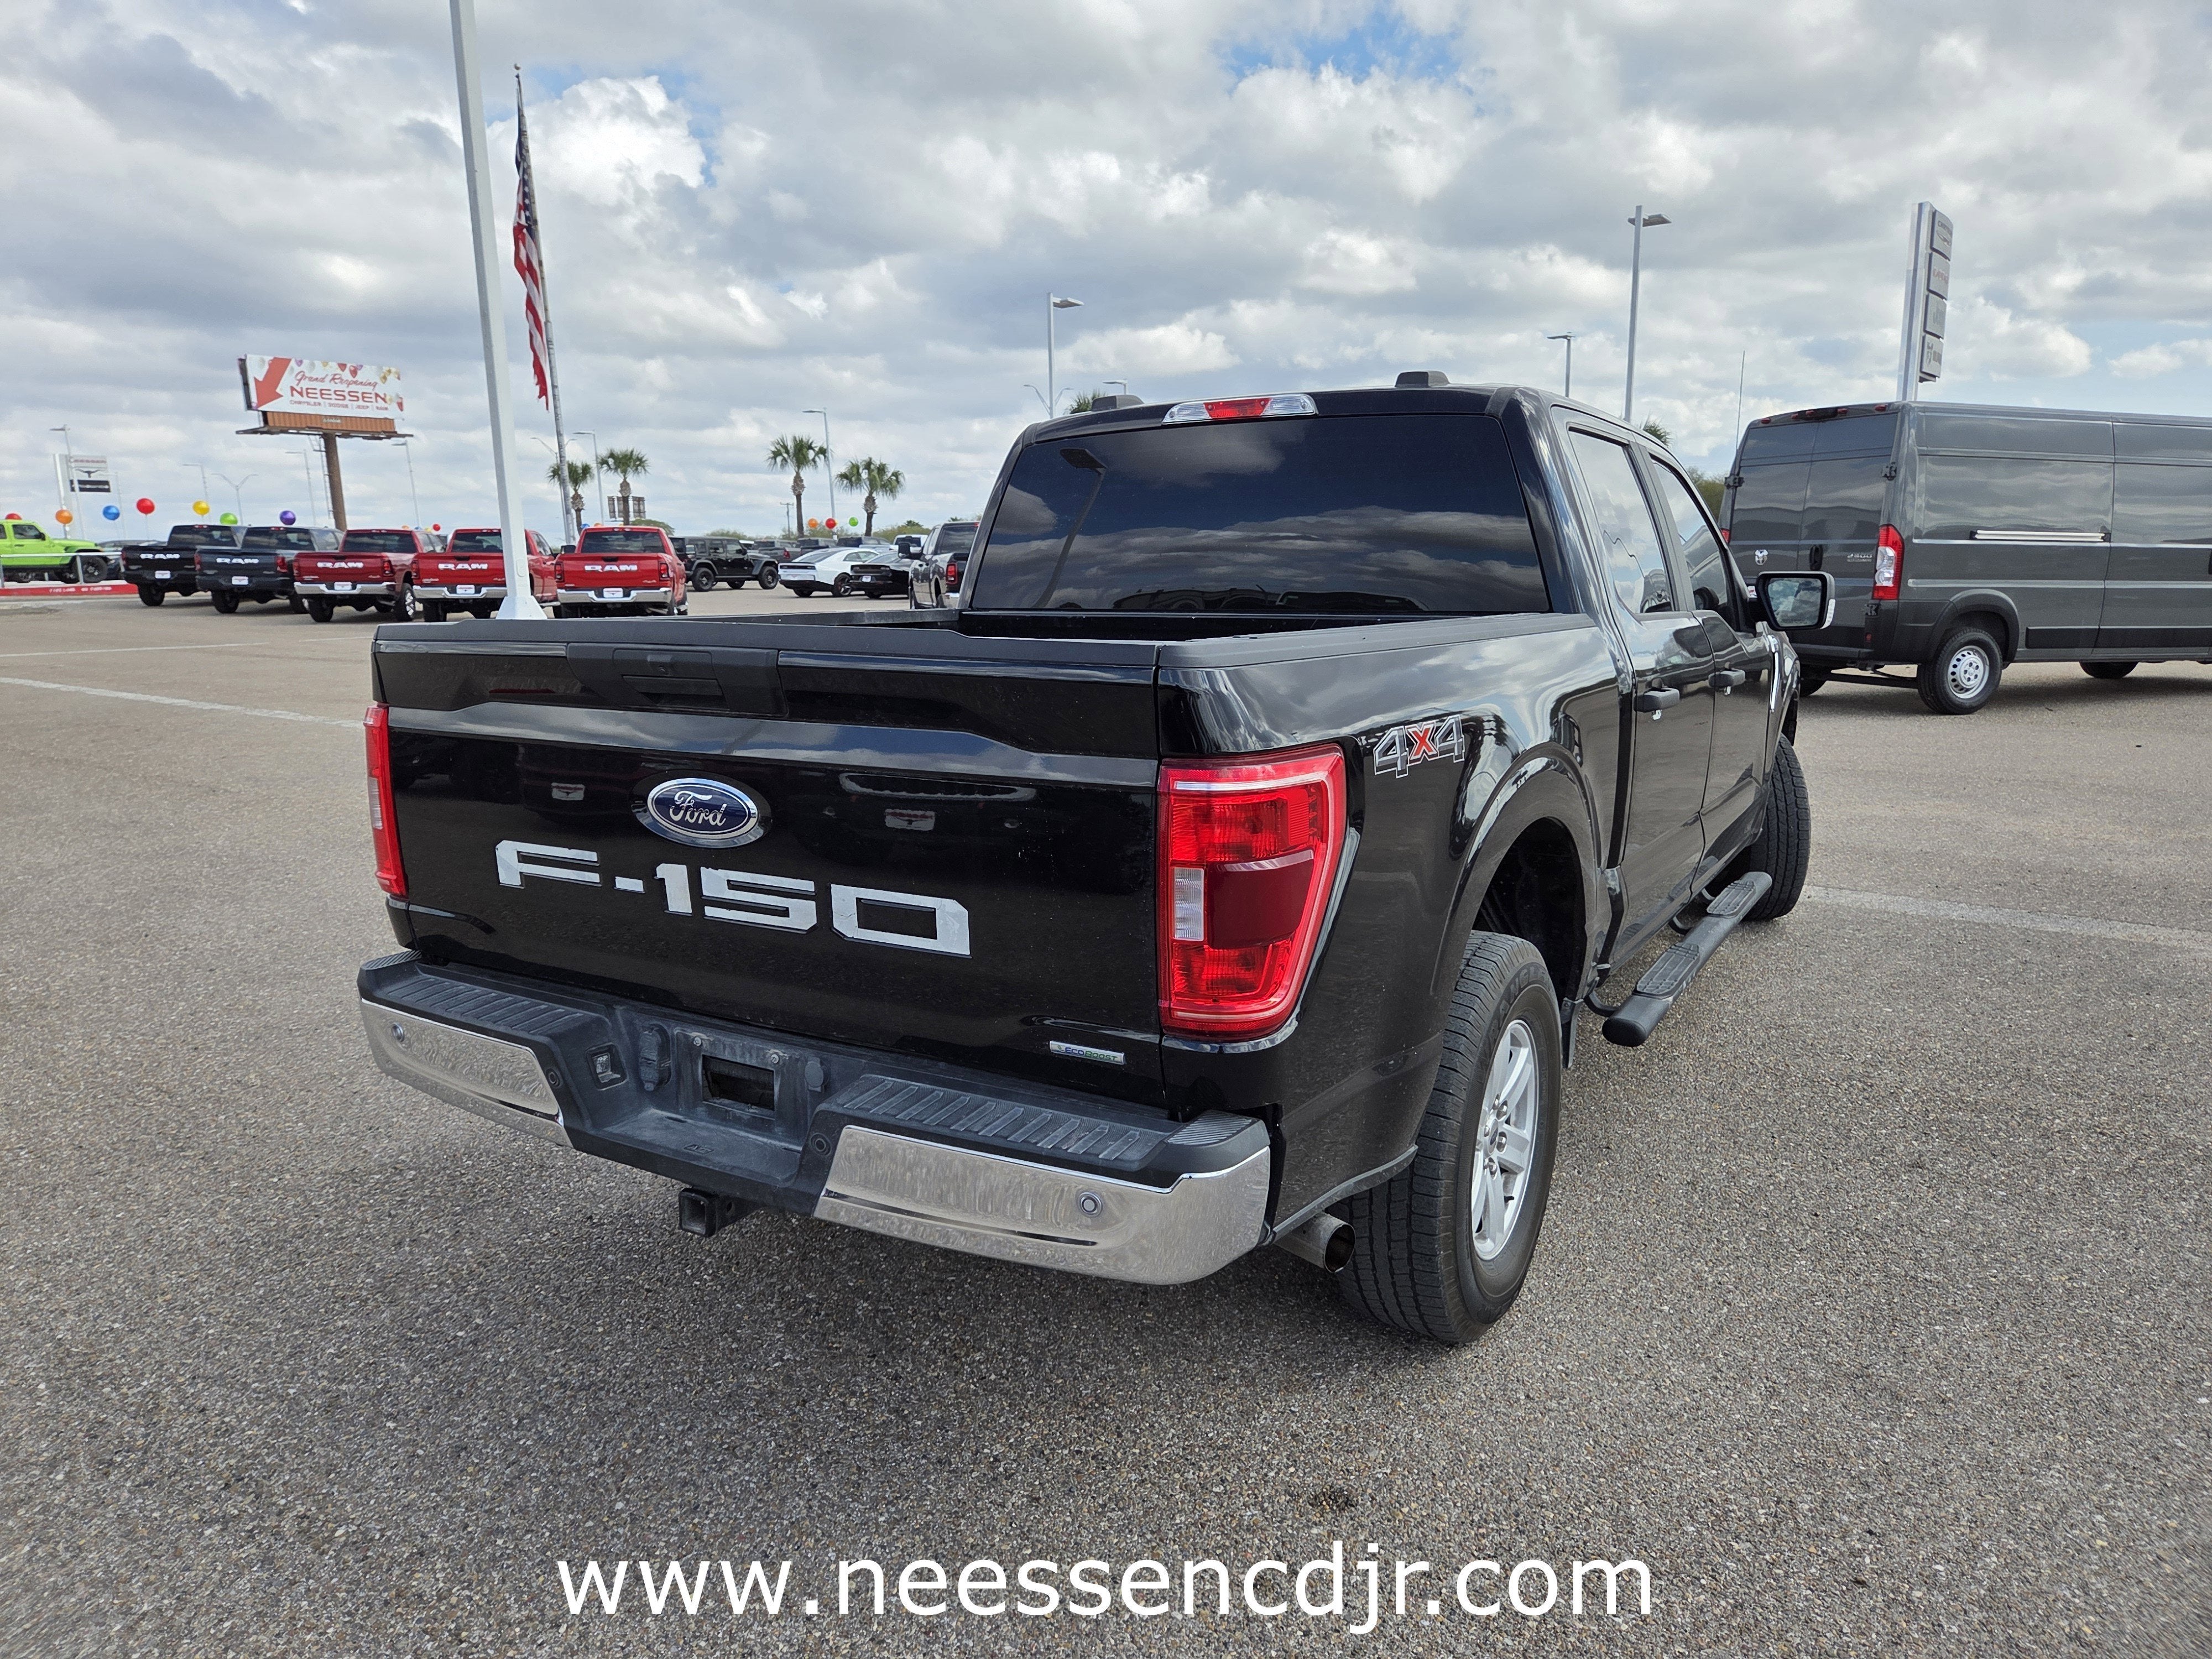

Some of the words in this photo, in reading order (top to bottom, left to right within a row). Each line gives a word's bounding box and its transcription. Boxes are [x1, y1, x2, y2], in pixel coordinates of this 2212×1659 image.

[295, 371, 328, 386] Grand
[290, 385, 388, 404] NEESSEN
[438, 562, 488, 571] RAM
[584, 564, 638, 572] RAM
[669, 790, 727, 827] Ford
[495, 839, 971, 958] F-150
